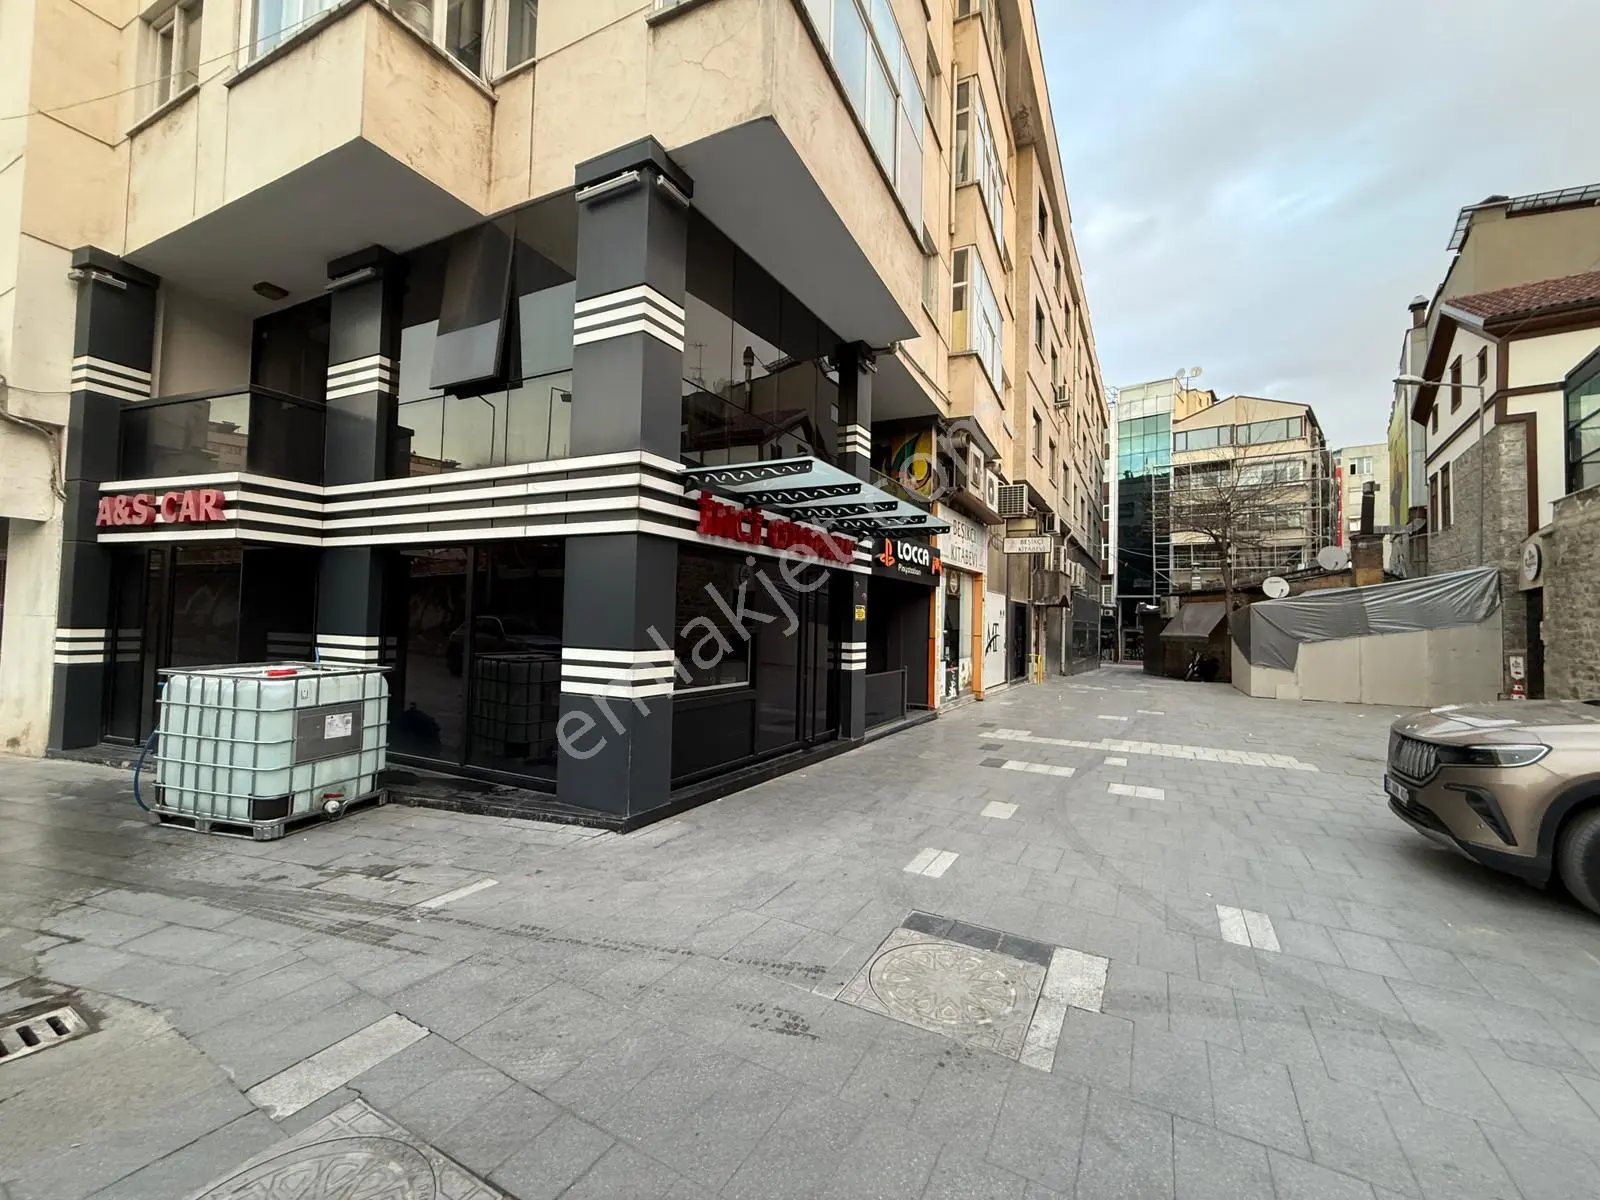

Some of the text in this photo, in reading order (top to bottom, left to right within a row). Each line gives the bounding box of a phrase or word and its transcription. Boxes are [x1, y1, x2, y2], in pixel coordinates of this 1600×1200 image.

[96, 488, 227, 526] A&S CAR
[897, 540, 929, 566] LOCCA
